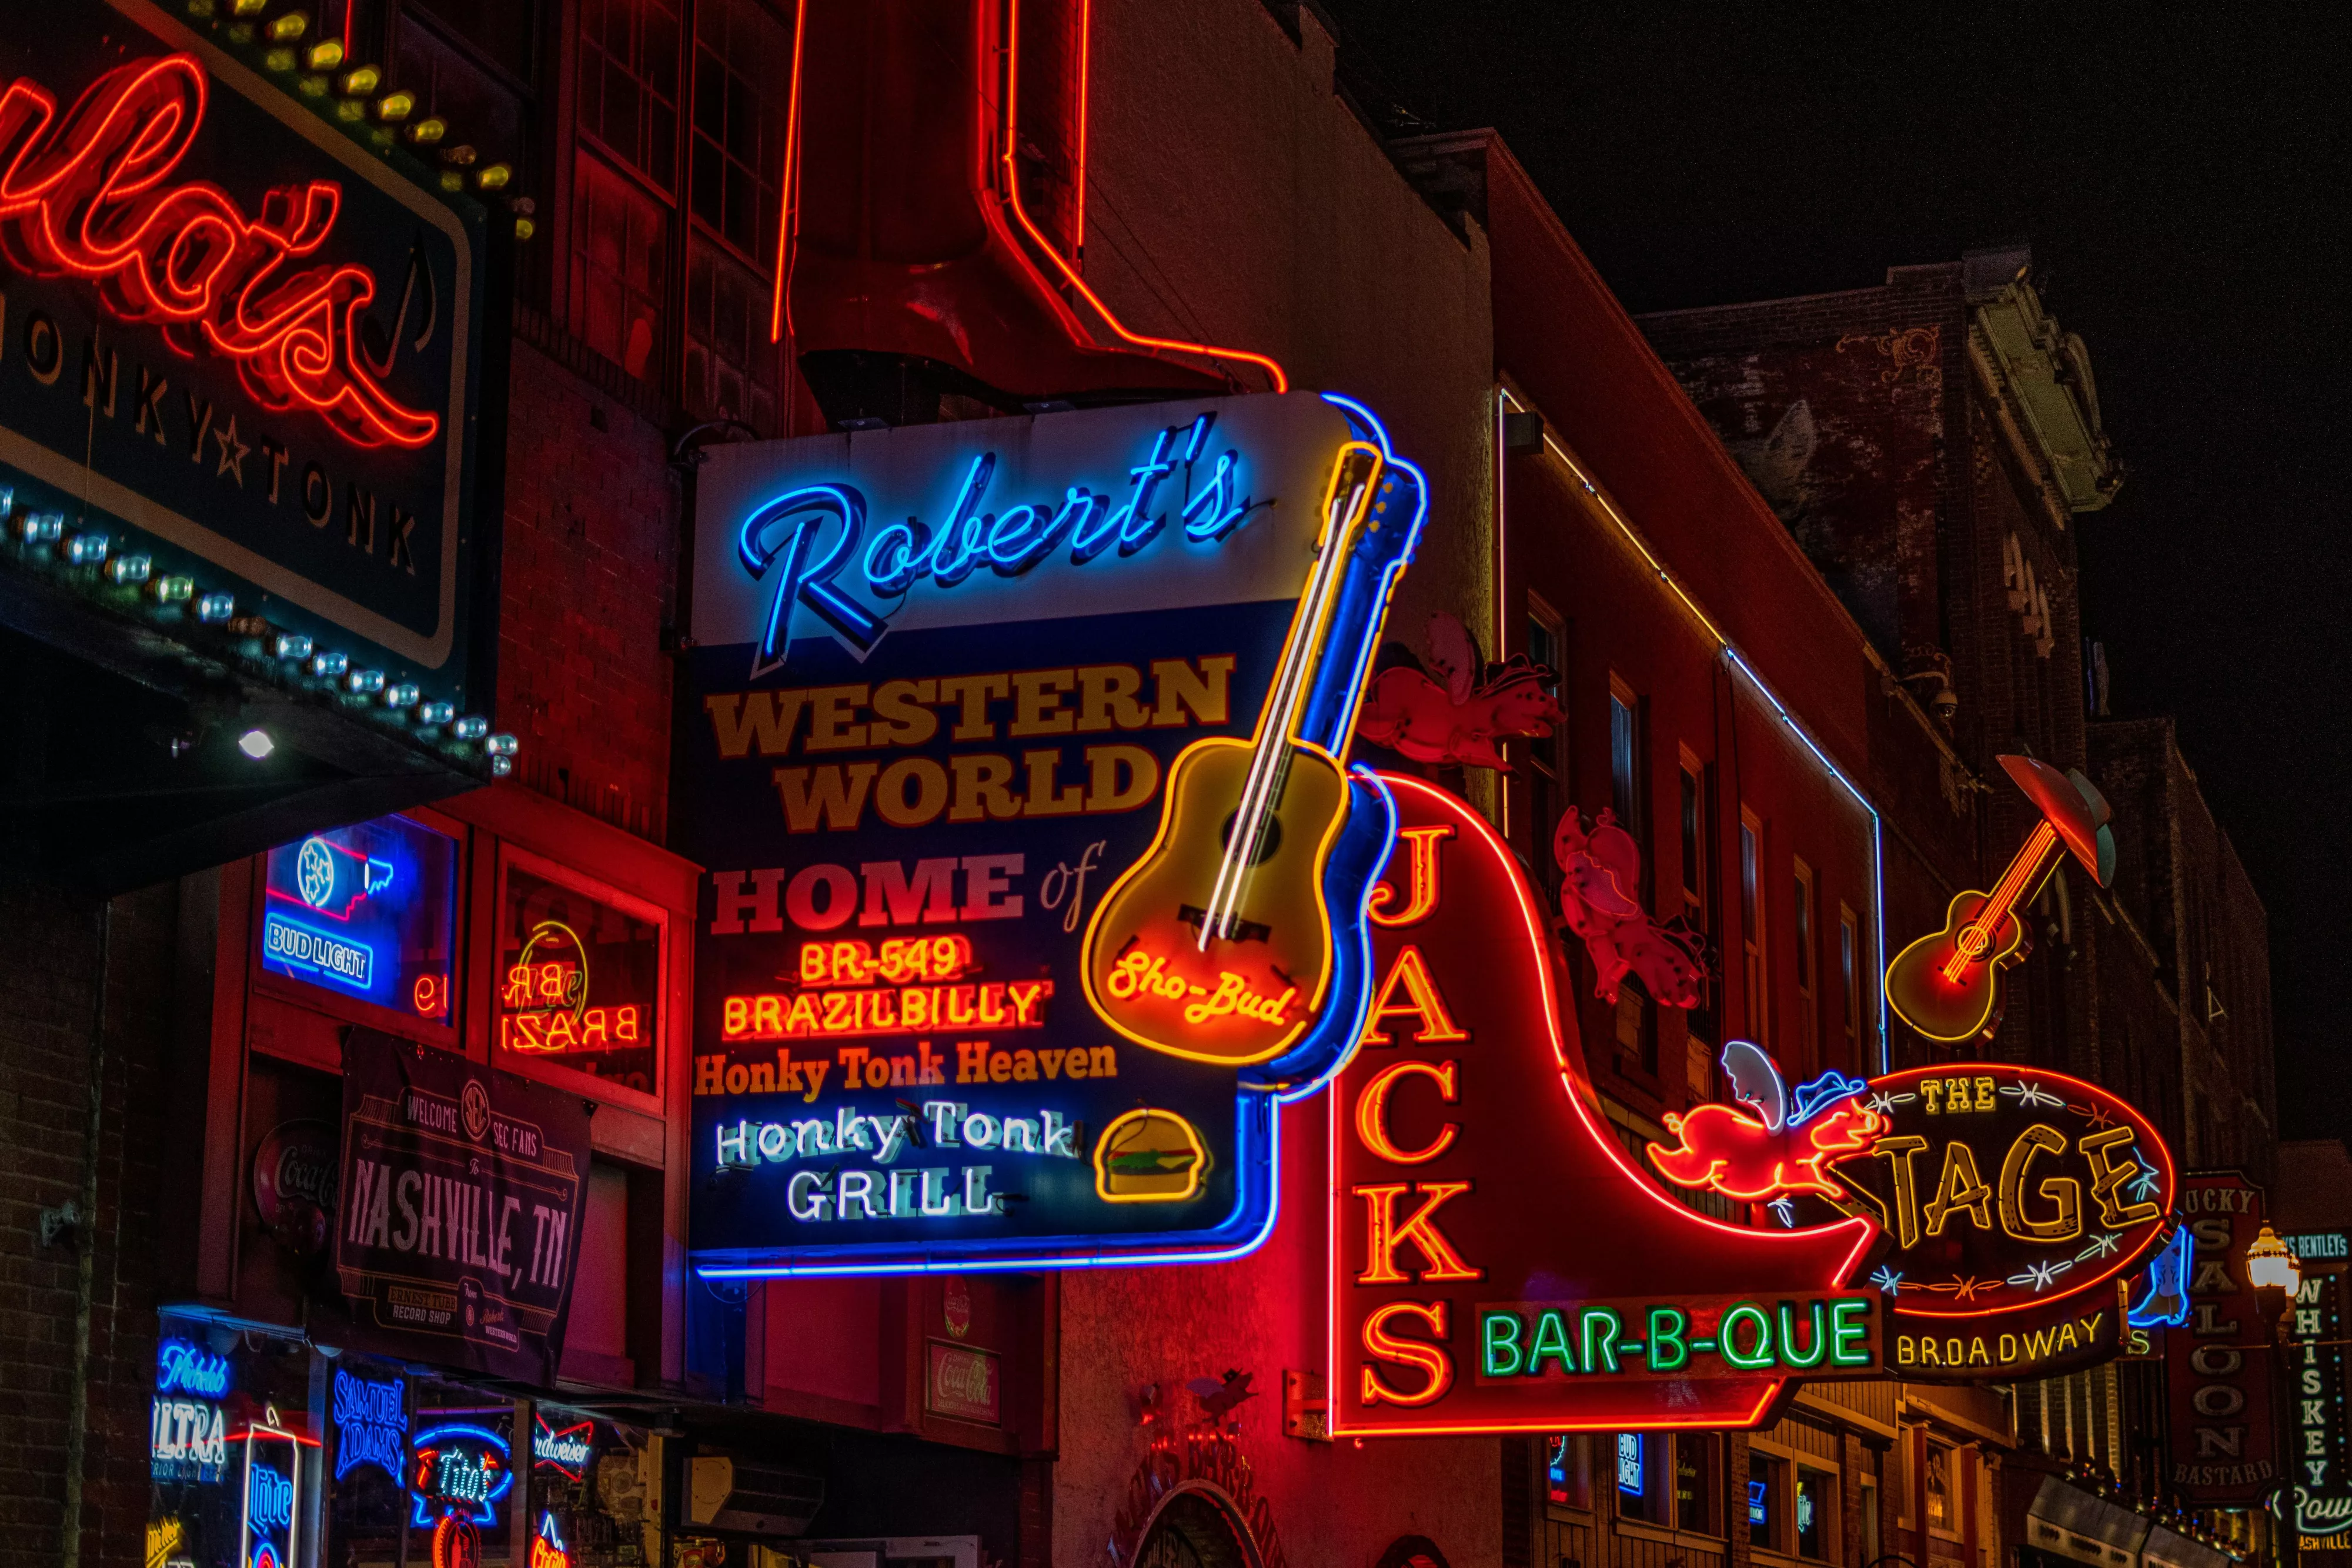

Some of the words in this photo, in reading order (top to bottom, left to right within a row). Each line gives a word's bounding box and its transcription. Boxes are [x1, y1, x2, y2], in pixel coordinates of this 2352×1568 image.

[0, 294, 213, 464] ONKY
[263, 434, 416, 575] TONK
[739, 412, 1252, 670] Robert's
[706, 654, 1237, 760] WESTERN
[773, 743, 1162, 834] WORLD
[711, 854, 1025, 935] HOME
[1041, 840, 1105, 933] of
[268, 922, 312, 960] BUD
[313, 937, 366, 979] LIGHT
[800, 934, 969, 987] BR-549
[723, 980, 1053, 1041] BRAZILBILLY
[1106, 951, 1296, 1027] Sho-Bud
[694, 1050, 829, 1102] Honky
[839, 1042, 946, 1088] Tonk
[956, 1042, 1117, 1084] Heaven
[1919, 1075, 1997, 1114] THE
[407, 1095, 458, 1134] WELCOME
[493, 1121, 509, 1149] SEC
[512, 1127, 537, 1157] FANS
[716, 1105, 907, 1164] Honky
[924, 1101, 1077, 1157] Tonk
[1354, 824, 1488, 1409] JACKS
[469, 1157, 479, 1175] To
[787, 1161, 1003, 1222] GRILL
[348, 1158, 522, 1291] NASHVILLE,
[529, 1204, 567, 1289] TN
[389, 1286, 430, 1307] ERNEST
[432, 1293, 457, 1310] TUBB
[392, 1305, 427, 1322] RECORD
[428, 1310, 451, 1325] SHOP
[464, 1282, 477, 1299] From
[485, 1325, 506, 1339] WESTERN
[1481, 1297, 1870, 1378] BAR-B-QUE
[1896, 1310, 2104, 1367] BROADWAY
[2190, 1218, 2244, 1459] SALOON
[333, 1370, 408, 1433] SAMUEL
[336, 1422, 402, 1480] ADAMS
[534, 1429, 589, 1462] udweiser
[1618, 1433, 1638, 1461] BUD
[2173, 1458, 2273, 1486] BASTARD
[248, 1463, 293, 1529] Lite
[440, 1449, 492, 1503] Tito's
